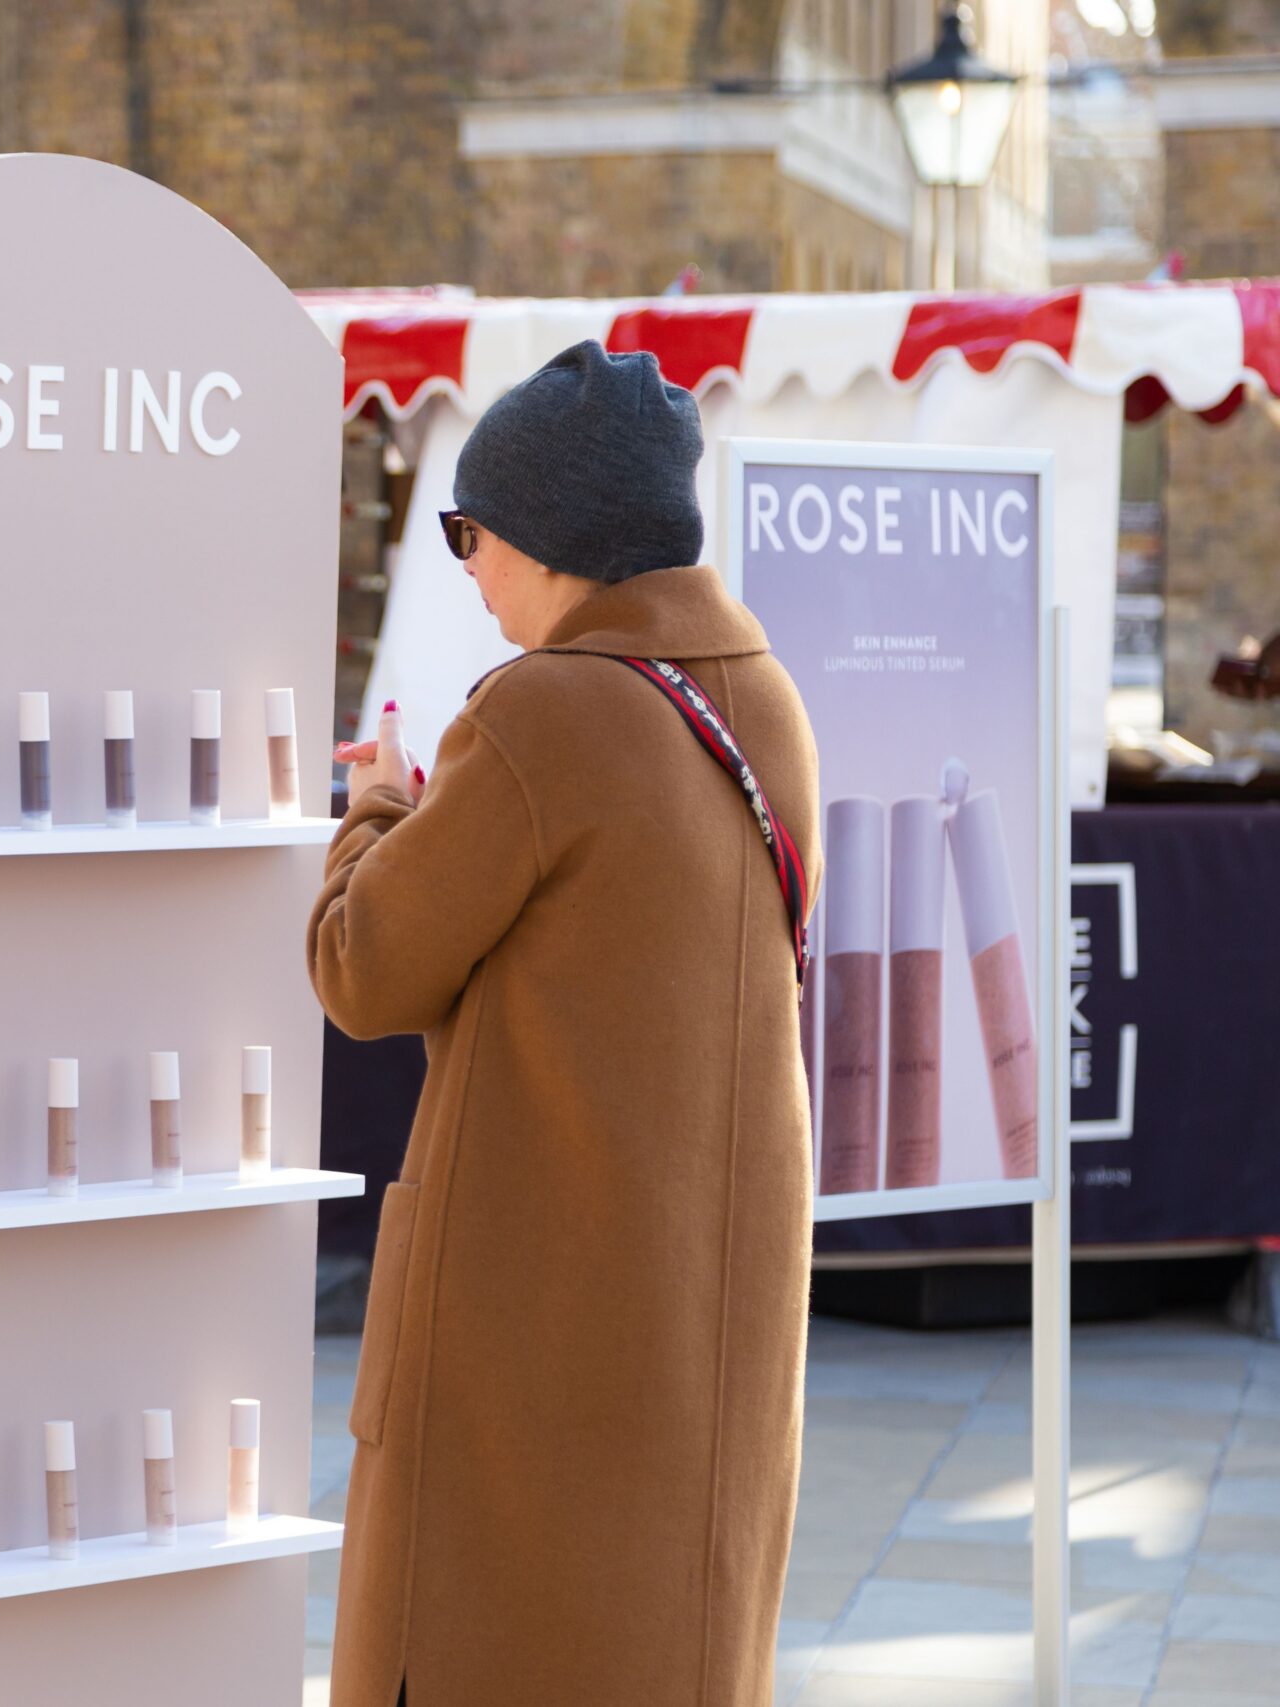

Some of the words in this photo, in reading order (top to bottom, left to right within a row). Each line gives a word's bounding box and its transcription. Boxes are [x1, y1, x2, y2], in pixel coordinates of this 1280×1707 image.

[102, 367, 243, 456] INC
[749, 482, 903, 555] ROSE
[930, 487, 1029, 557] INC
[824, 656, 884, 671] LUMINOUS
[887, 656, 926, 671] TINTED
[929, 656, 966, 671] SERUM
[853, 636, 880, 651] SKIN
[883, 636, 938, 651] ENHANCE
